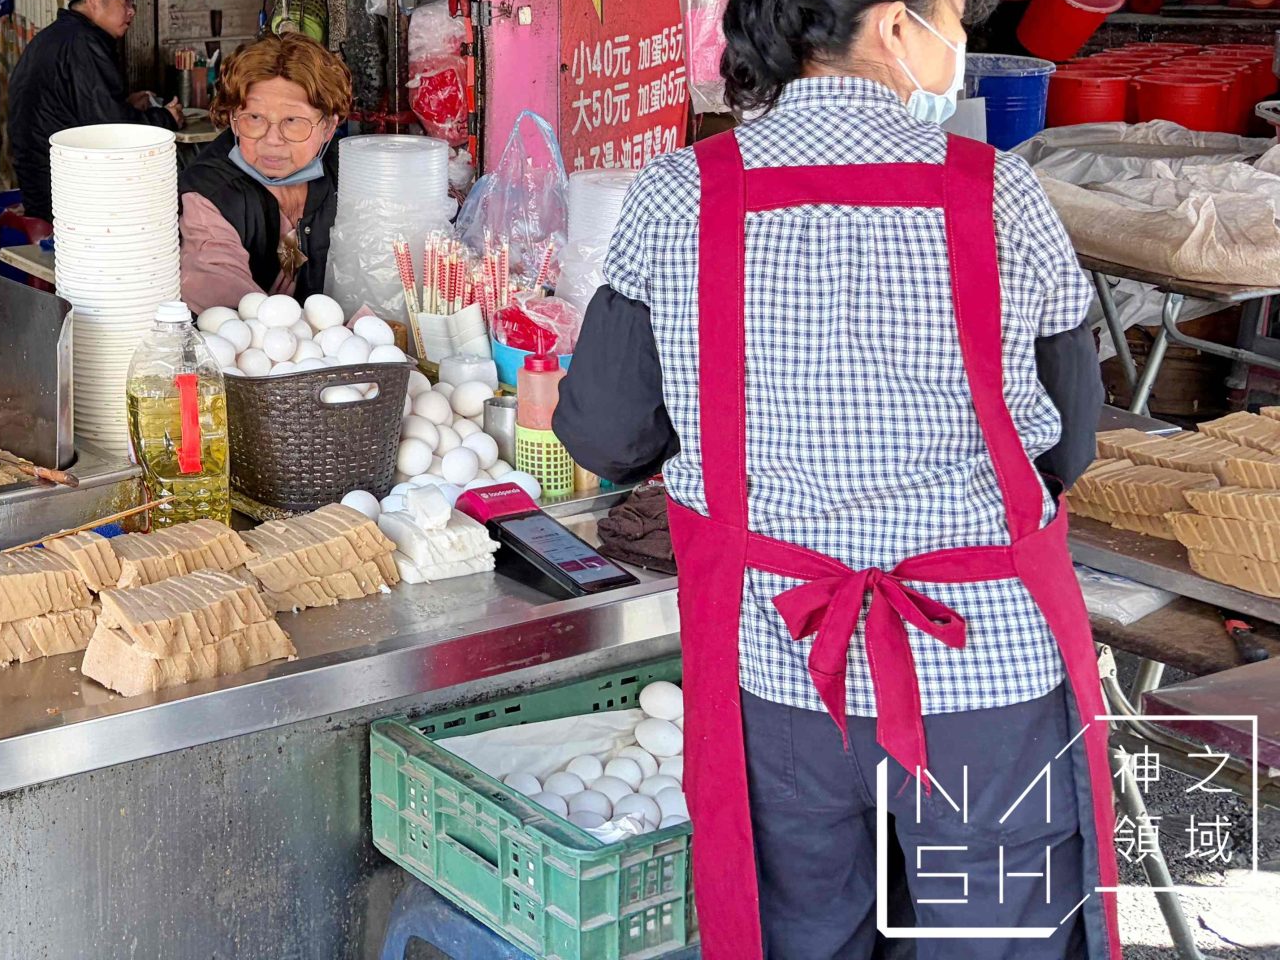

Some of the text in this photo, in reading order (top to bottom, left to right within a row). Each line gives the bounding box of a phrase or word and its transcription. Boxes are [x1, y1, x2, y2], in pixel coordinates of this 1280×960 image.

[572, 35, 631, 85] 小40元
[571, 66, 686, 136] 大50元 加蛋65元
